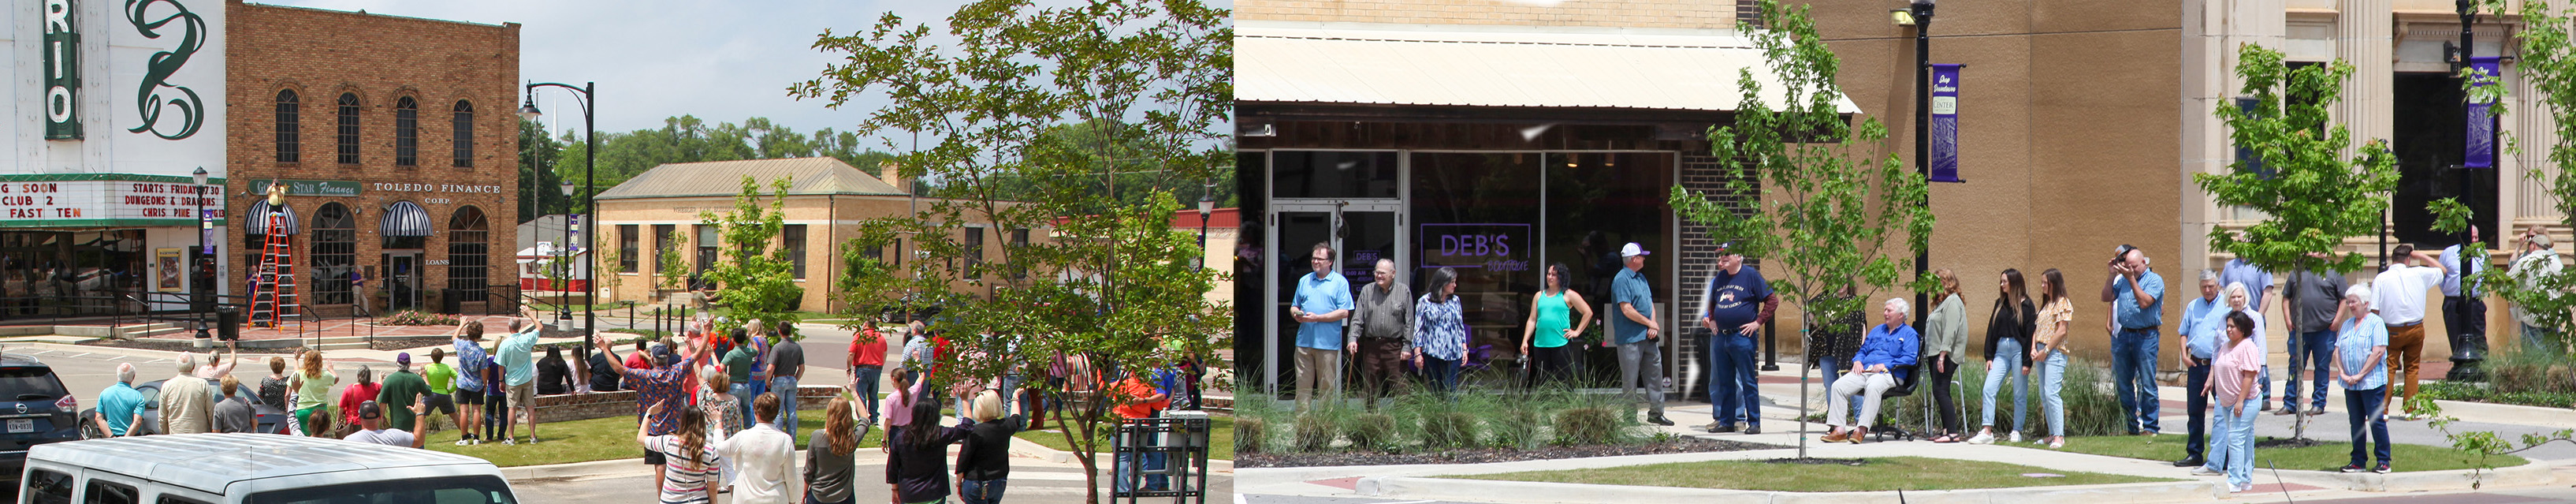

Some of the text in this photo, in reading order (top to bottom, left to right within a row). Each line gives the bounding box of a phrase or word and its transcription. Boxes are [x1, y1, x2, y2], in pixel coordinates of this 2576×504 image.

[46, 0, 71, 123] RIO
[1934, 100, 1953, 109] CENTER
[22, 183, 57, 193] SOON
[133, 183, 164, 193] STARTS
[170, 185, 197, 194] FRIDAY
[293, 181, 315, 193] STAR
[318, 181, 355, 194] Finance
[374, 182, 501, 193] TOLEDO FINANCE
[2, 196, 54, 206] CLUB 2
[125, 195, 166, 205] DUNGEONS
[169, 196, 176, 206] &
[9, 208, 81, 218] FAST TEN
[143, 207, 166, 218] CHRIS
[173, 208, 191, 218] PINE
[1441, 234, 1510, 256] DEB'S
[1356, 252, 1378, 261] DEB'S
[1487, 259, 1528, 271] BOUTIQUE
